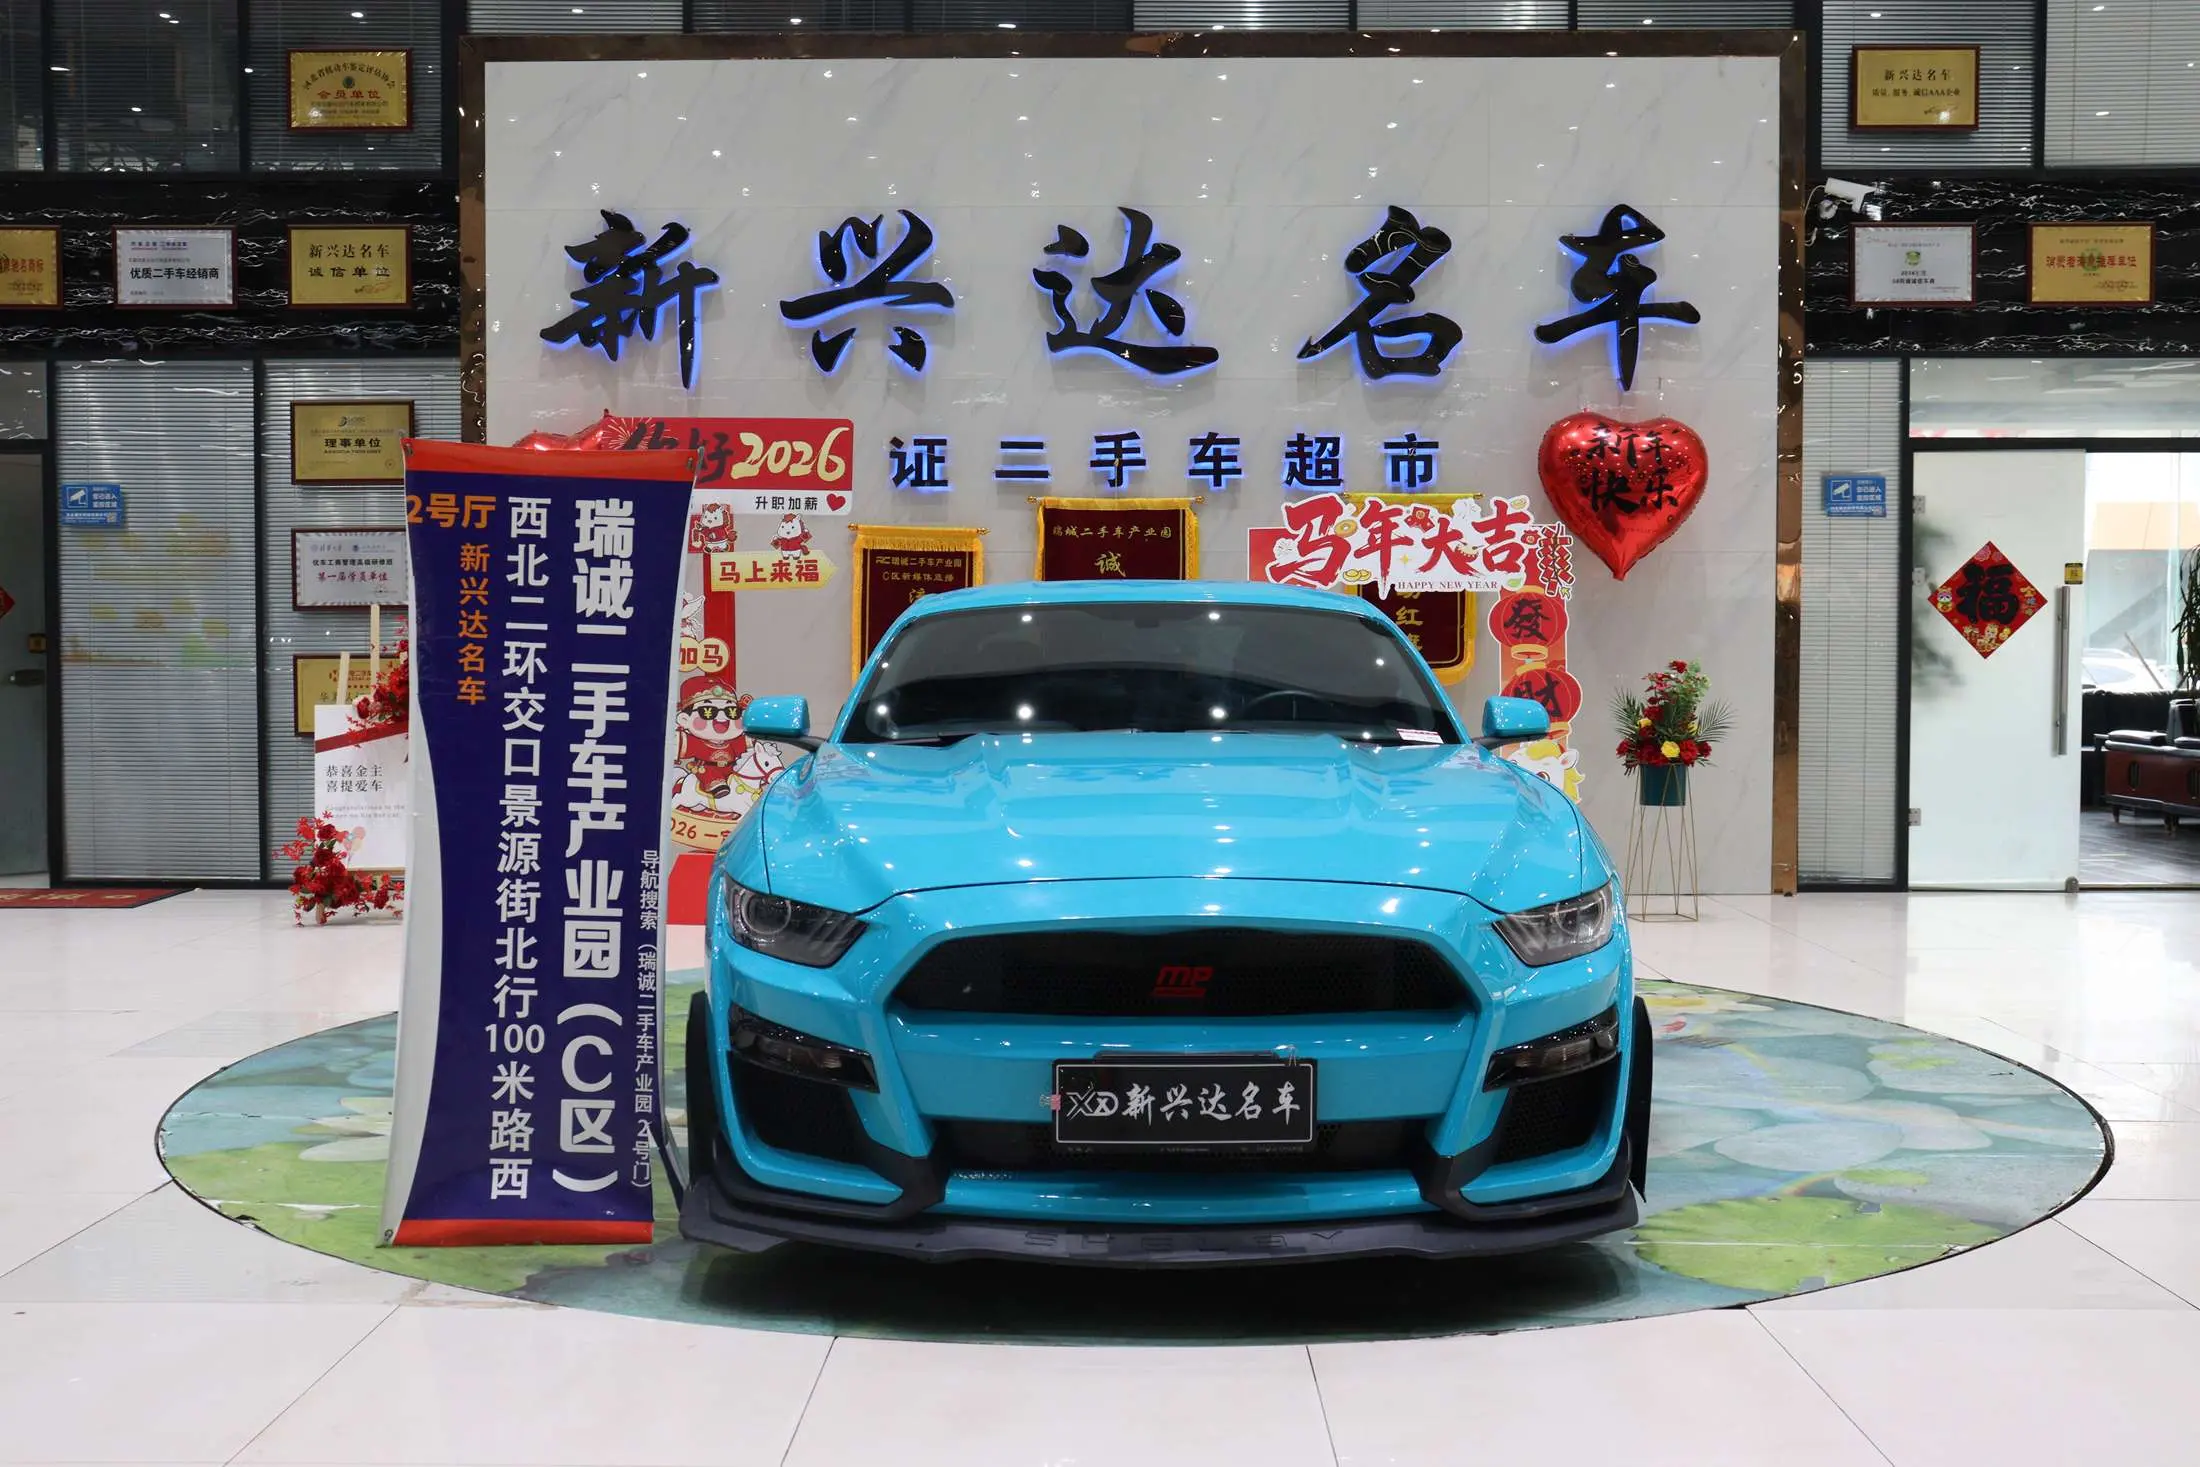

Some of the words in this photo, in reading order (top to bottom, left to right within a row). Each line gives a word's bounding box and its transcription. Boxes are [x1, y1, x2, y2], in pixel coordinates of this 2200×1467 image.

[1885, 69, 1950, 80] 新兴达名车
[317, 90, 382, 99] 会员单位
[309, 243, 390, 259] 新兴达名车
[130, 267, 219, 280] 优质二手车经销商
[308, 266, 390, 278] 诚信单位
[540, 204, 1703, 392] 新兴达名车
[324, 438, 381, 449] 理事单位
[730, 427, 850, 482] 2026
[889, 433, 1444, 490] 证二手车超市
[755, 496, 819, 511] 升职加薪
[1268, 496, 1531, 590] 马年大吉
[719, 559, 821, 583] 马上来福
[1398, 581, 1435, 590] HAPPY
[1439, 581, 1464, 590] NEW
[1467, 581, 1498, 590] YEAR
[1956, 563, 2019, 625] 福
[456, 542, 490, 706] 新兴达名车
[326, 764, 384, 778] 恭喜金主
[326, 780, 384, 793] 喜提爱车
[485, 496, 552, 1200] 西北二环交口景源街北行100米路西
[1122, 1081, 1301, 1126] 新兴达名车
